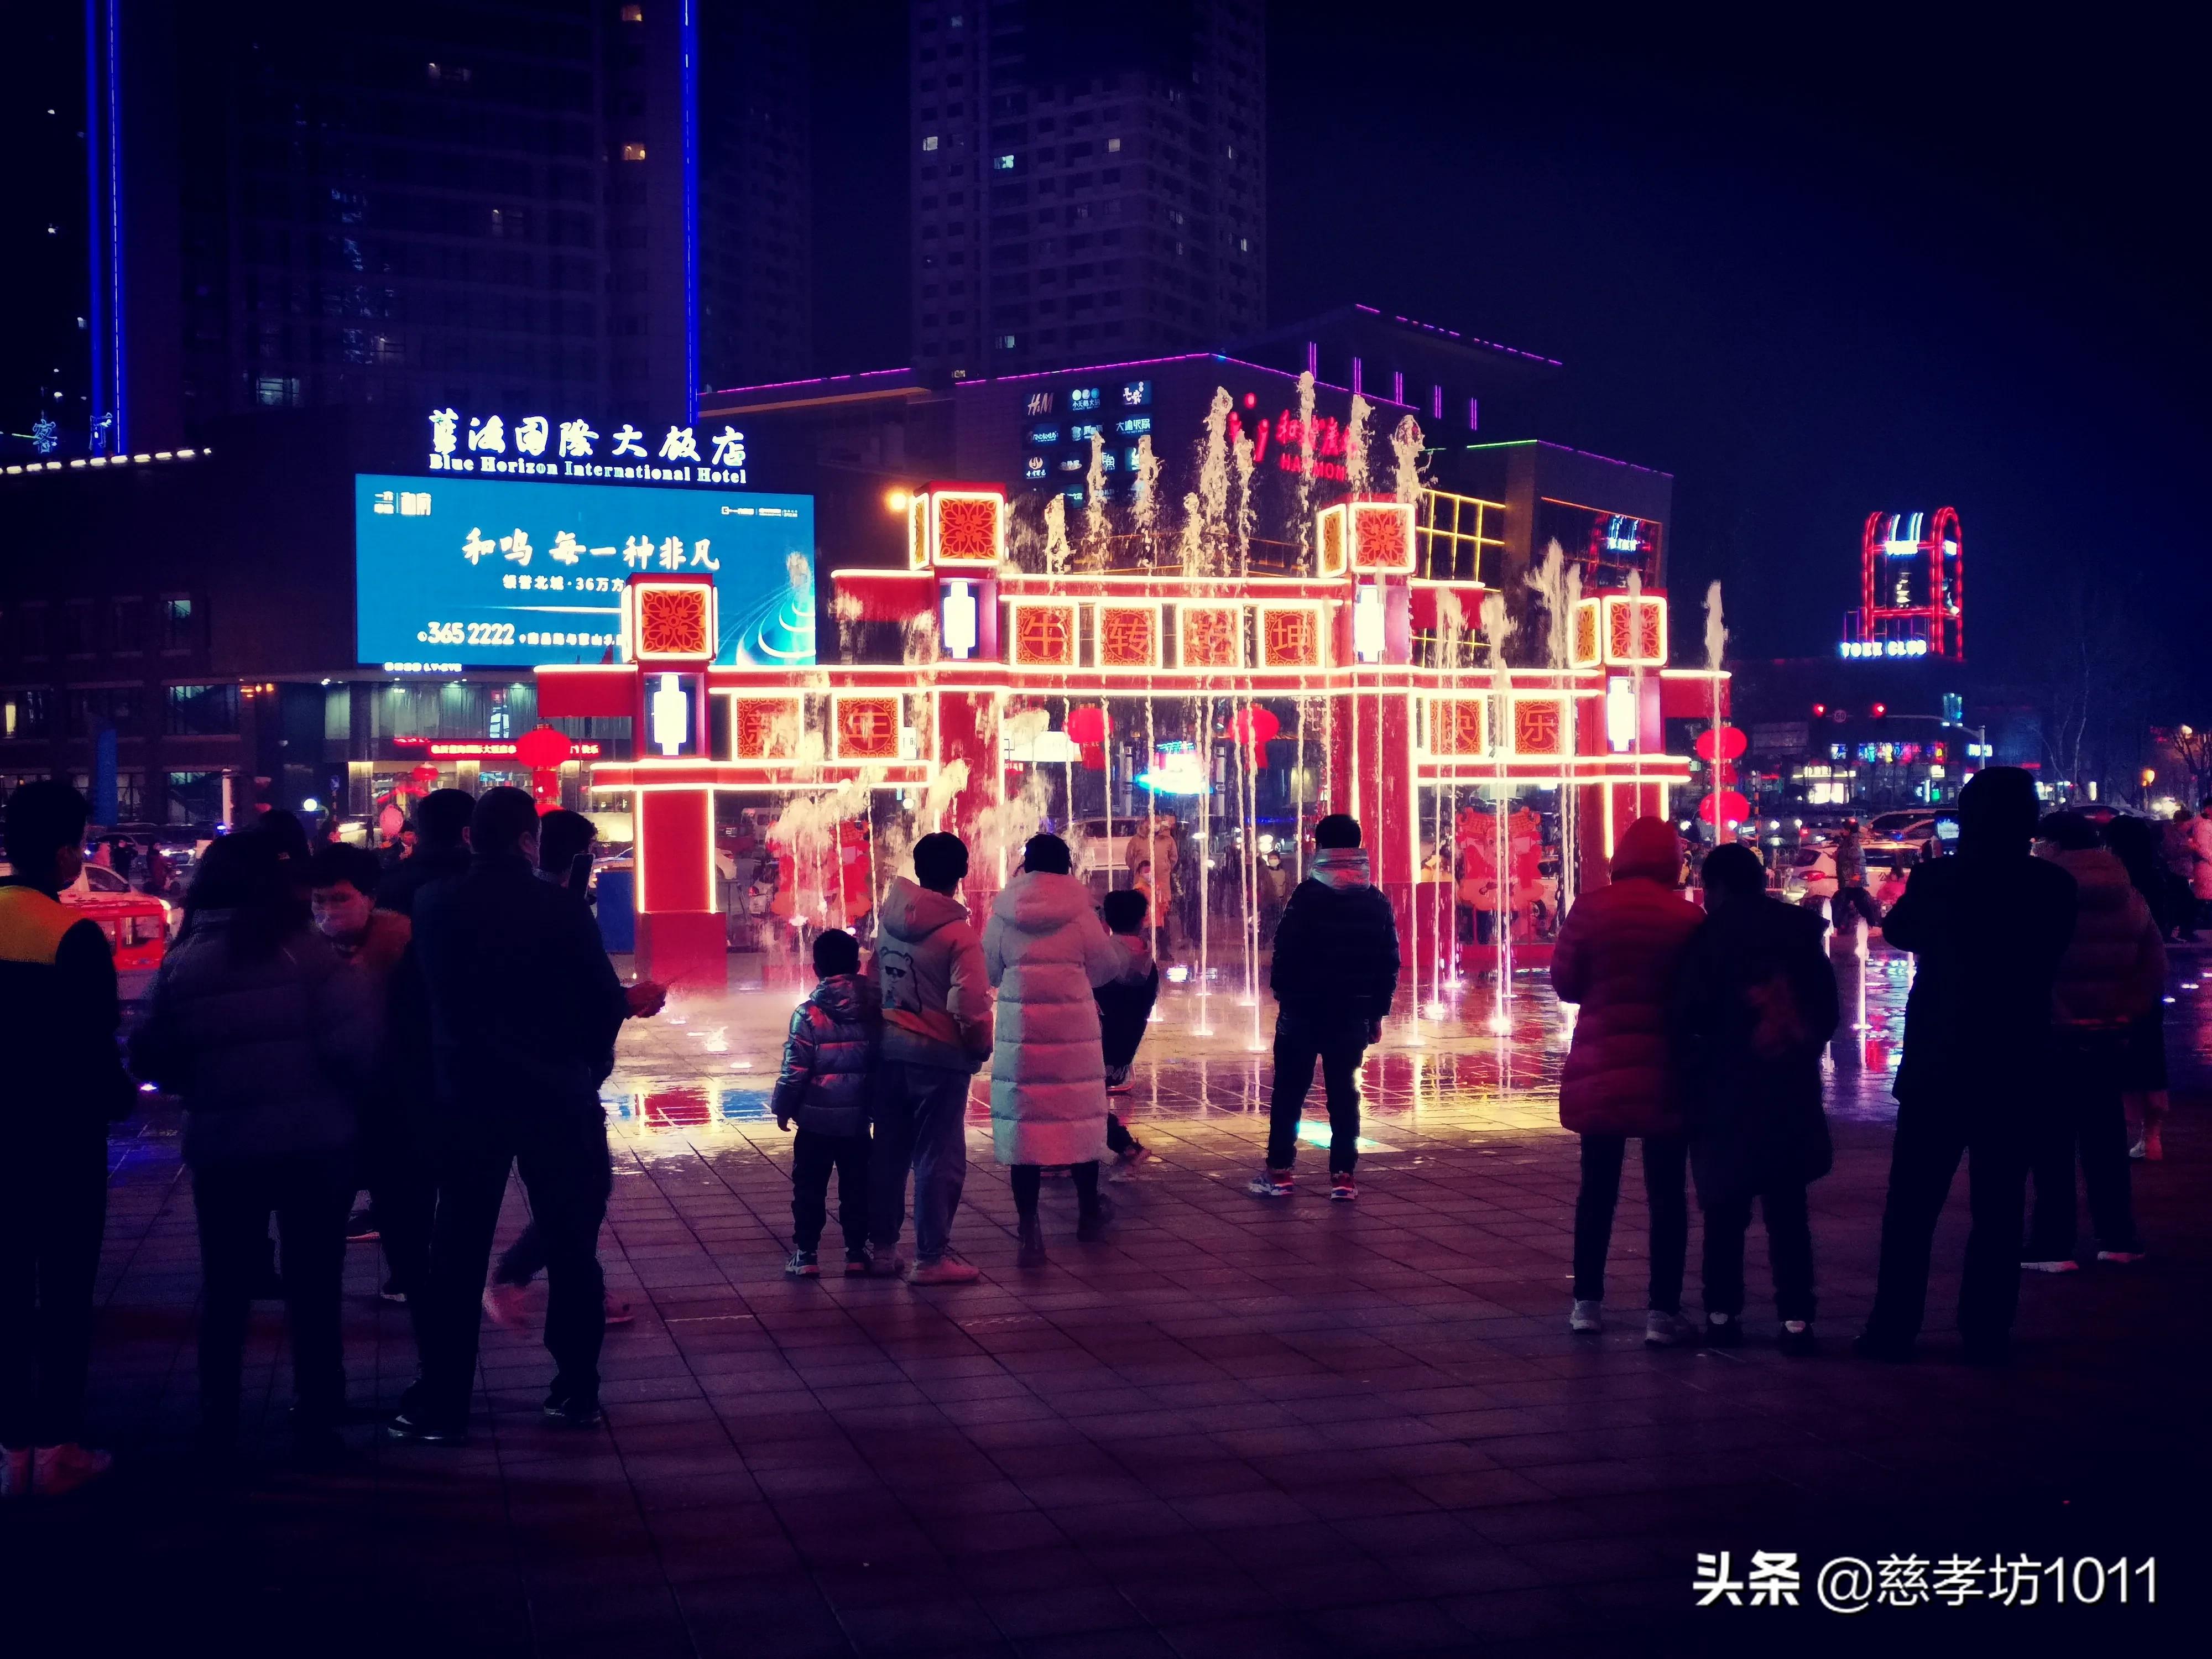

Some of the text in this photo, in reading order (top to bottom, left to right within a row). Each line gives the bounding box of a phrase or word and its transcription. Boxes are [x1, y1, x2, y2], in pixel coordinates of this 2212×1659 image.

[1027, 393, 1053, 415] H&M
[429, 454, 747, 484] Blue Horizon International Hotel
[1280, 453, 1347, 482] HAMON
[549, 530, 720, 571] 每一种非凡
